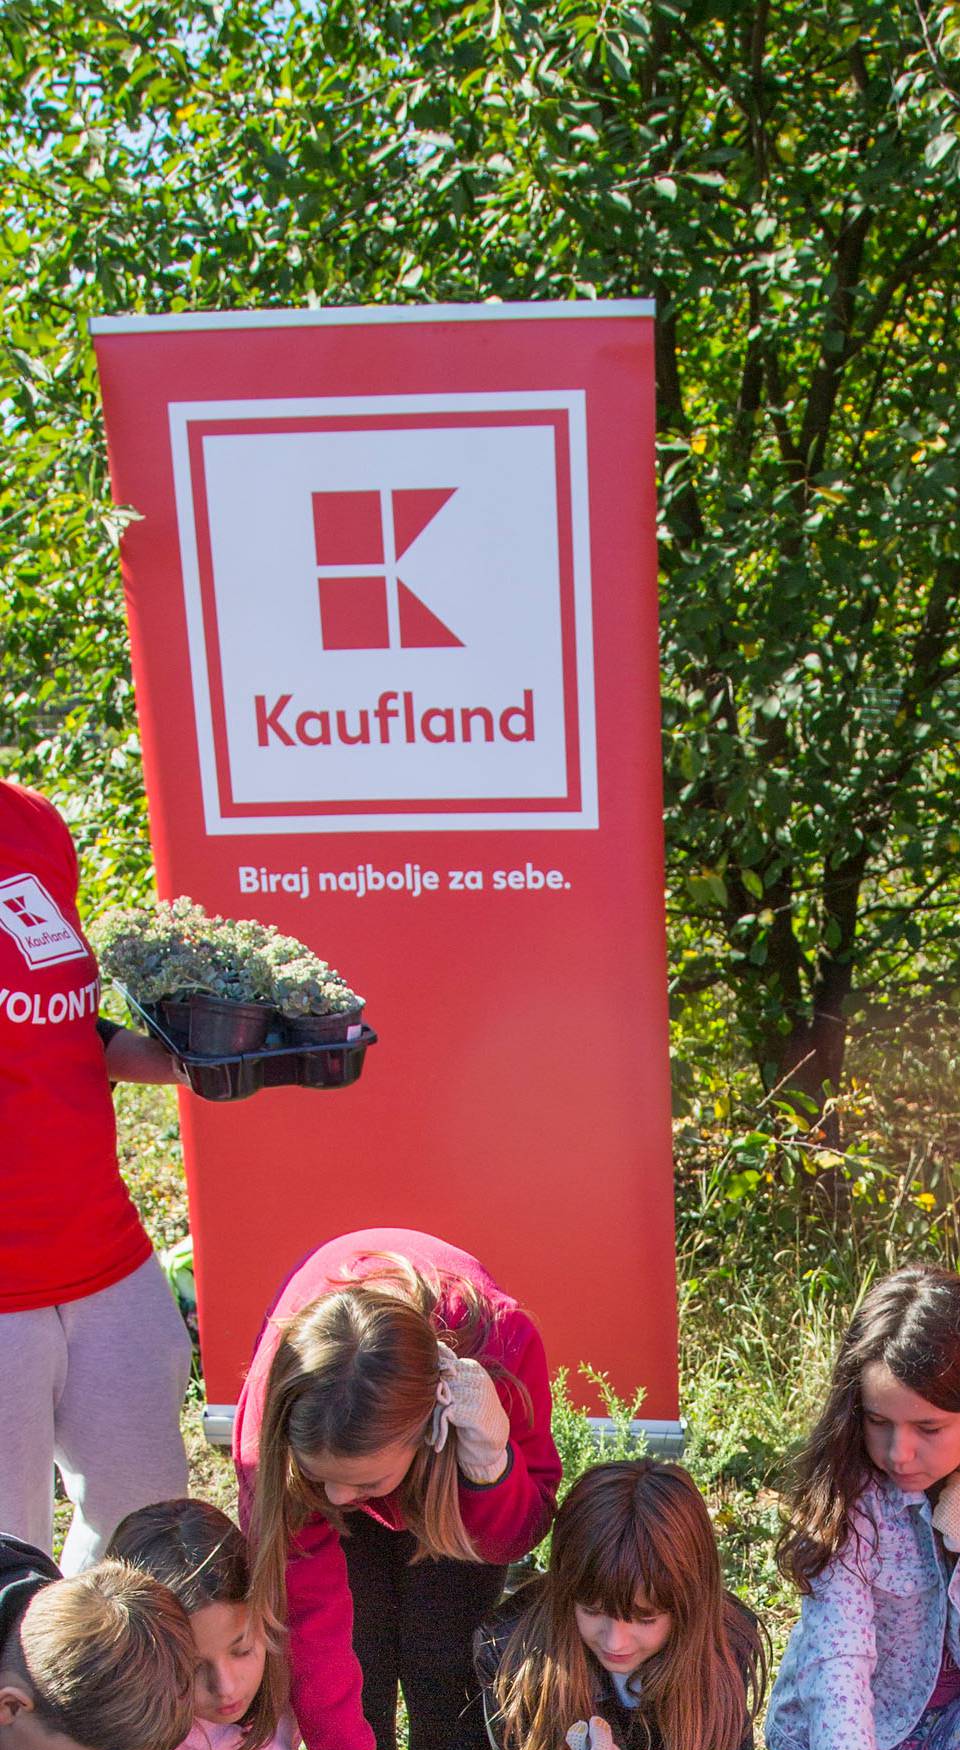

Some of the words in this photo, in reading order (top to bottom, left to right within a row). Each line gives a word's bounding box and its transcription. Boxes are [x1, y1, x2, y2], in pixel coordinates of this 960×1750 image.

[254, 689, 535, 747] Kaufland
[238, 866, 309, 899] Biraj
[319, 863, 439, 897] najbolje
[448, 870, 484, 890] za
[493, 862, 571, 890] sebe.
[25, 930, 72, 949] Kaufland
